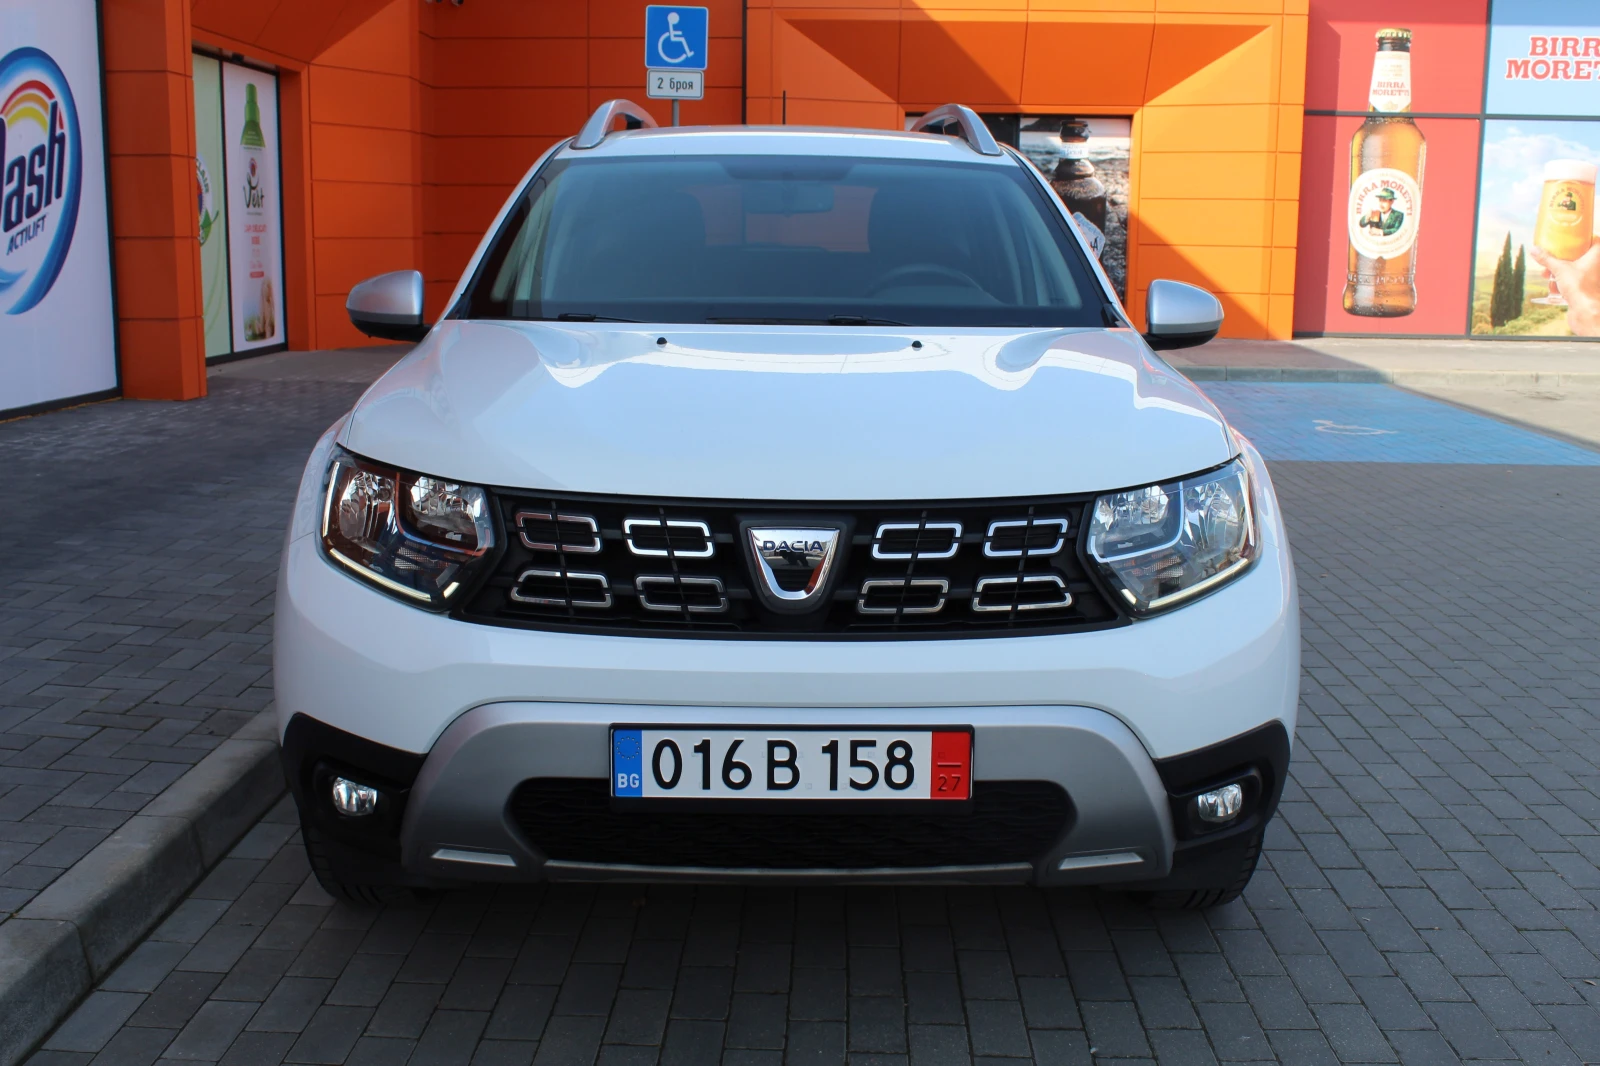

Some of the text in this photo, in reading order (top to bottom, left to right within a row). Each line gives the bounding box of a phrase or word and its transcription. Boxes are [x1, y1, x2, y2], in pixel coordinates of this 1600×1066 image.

[657, 77, 694, 92] 2 броя
[1377, 81, 1406, 89] BIRRA
[1356, 179, 1413, 216] BIRRA MORETTI
[6, 215, 47, 256] ACTILIFT
[763, 540, 823, 552] DACIA
[617, 773, 640, 789] BG
[937, 774, 961, 792] 27
